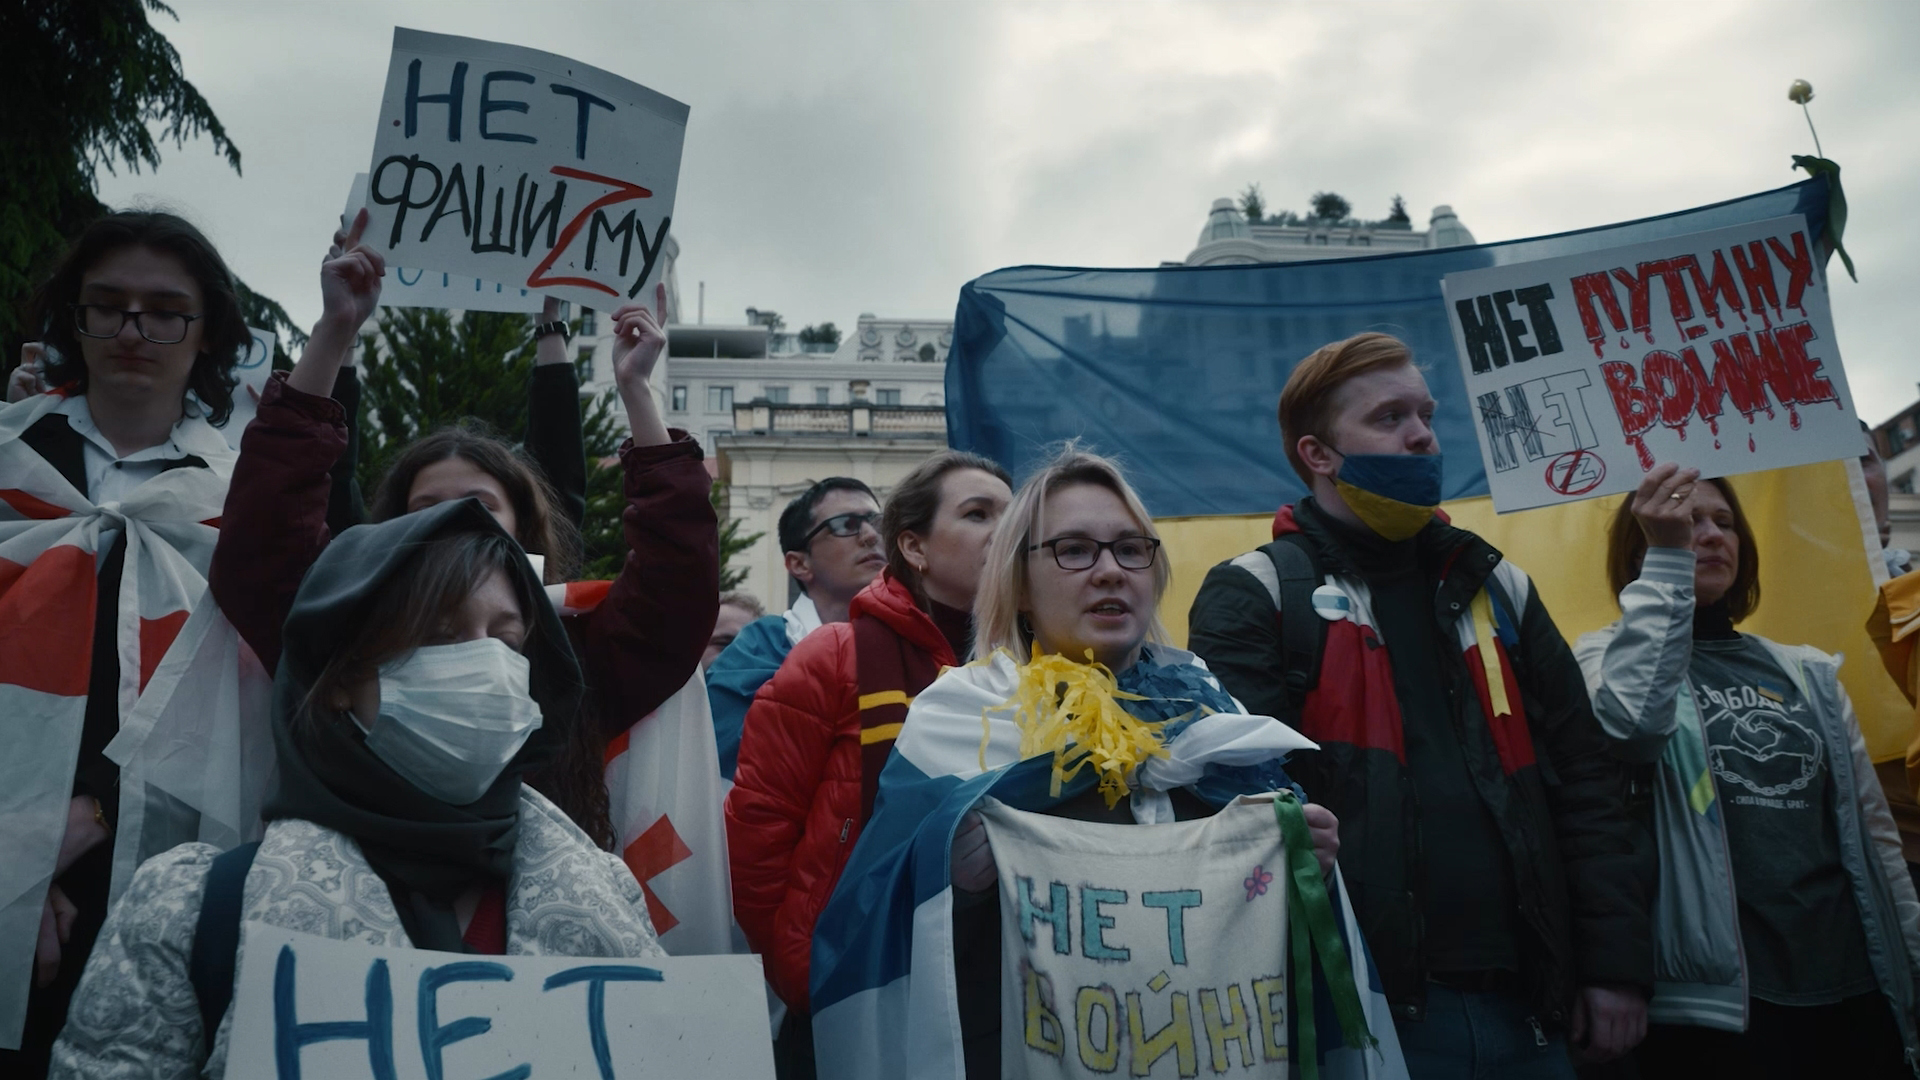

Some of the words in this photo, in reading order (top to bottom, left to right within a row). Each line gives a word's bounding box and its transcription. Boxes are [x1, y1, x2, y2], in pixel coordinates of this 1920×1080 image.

[405, 58, 616, 160] НЕТ
[371, 154, 671, 299] ФАШИZМУ
[1455, 283, 1565, 375] НЕТ
[1570, 231, 1815, 350] ПУТИНУ
[1477, 368, 1599, 473] НЕТ
[1600, 320, 1842, 445] ВОЙНЕ
[1014, 873, 1203, 966] НЕТ
[273, 944, 665, 1080] НЕТ
